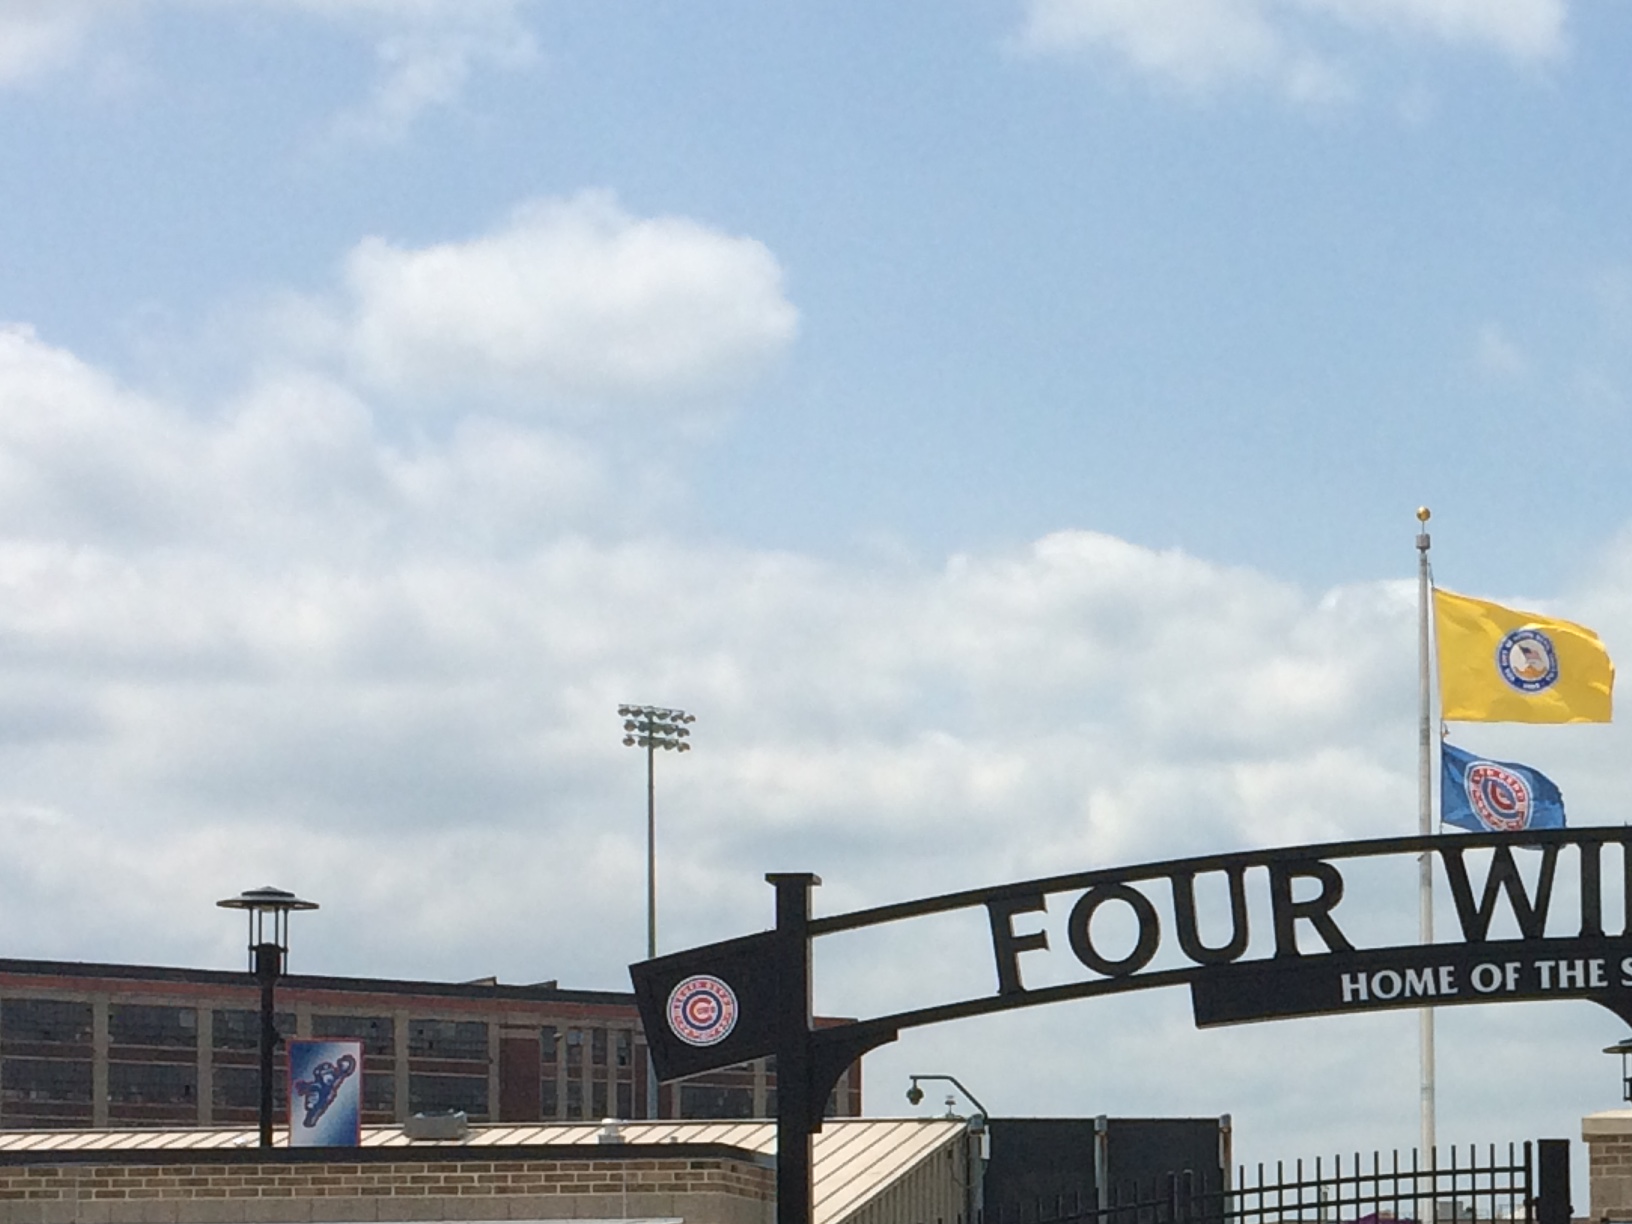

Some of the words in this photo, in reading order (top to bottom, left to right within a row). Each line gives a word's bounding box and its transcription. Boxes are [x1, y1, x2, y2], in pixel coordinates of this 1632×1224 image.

[984, 860, 1356, 993] FOUR
[1341, 965, 1458, 1002] HOME
[1471, 962, 1521, 993] OF
[1535, 959, 1608, 989] THE
